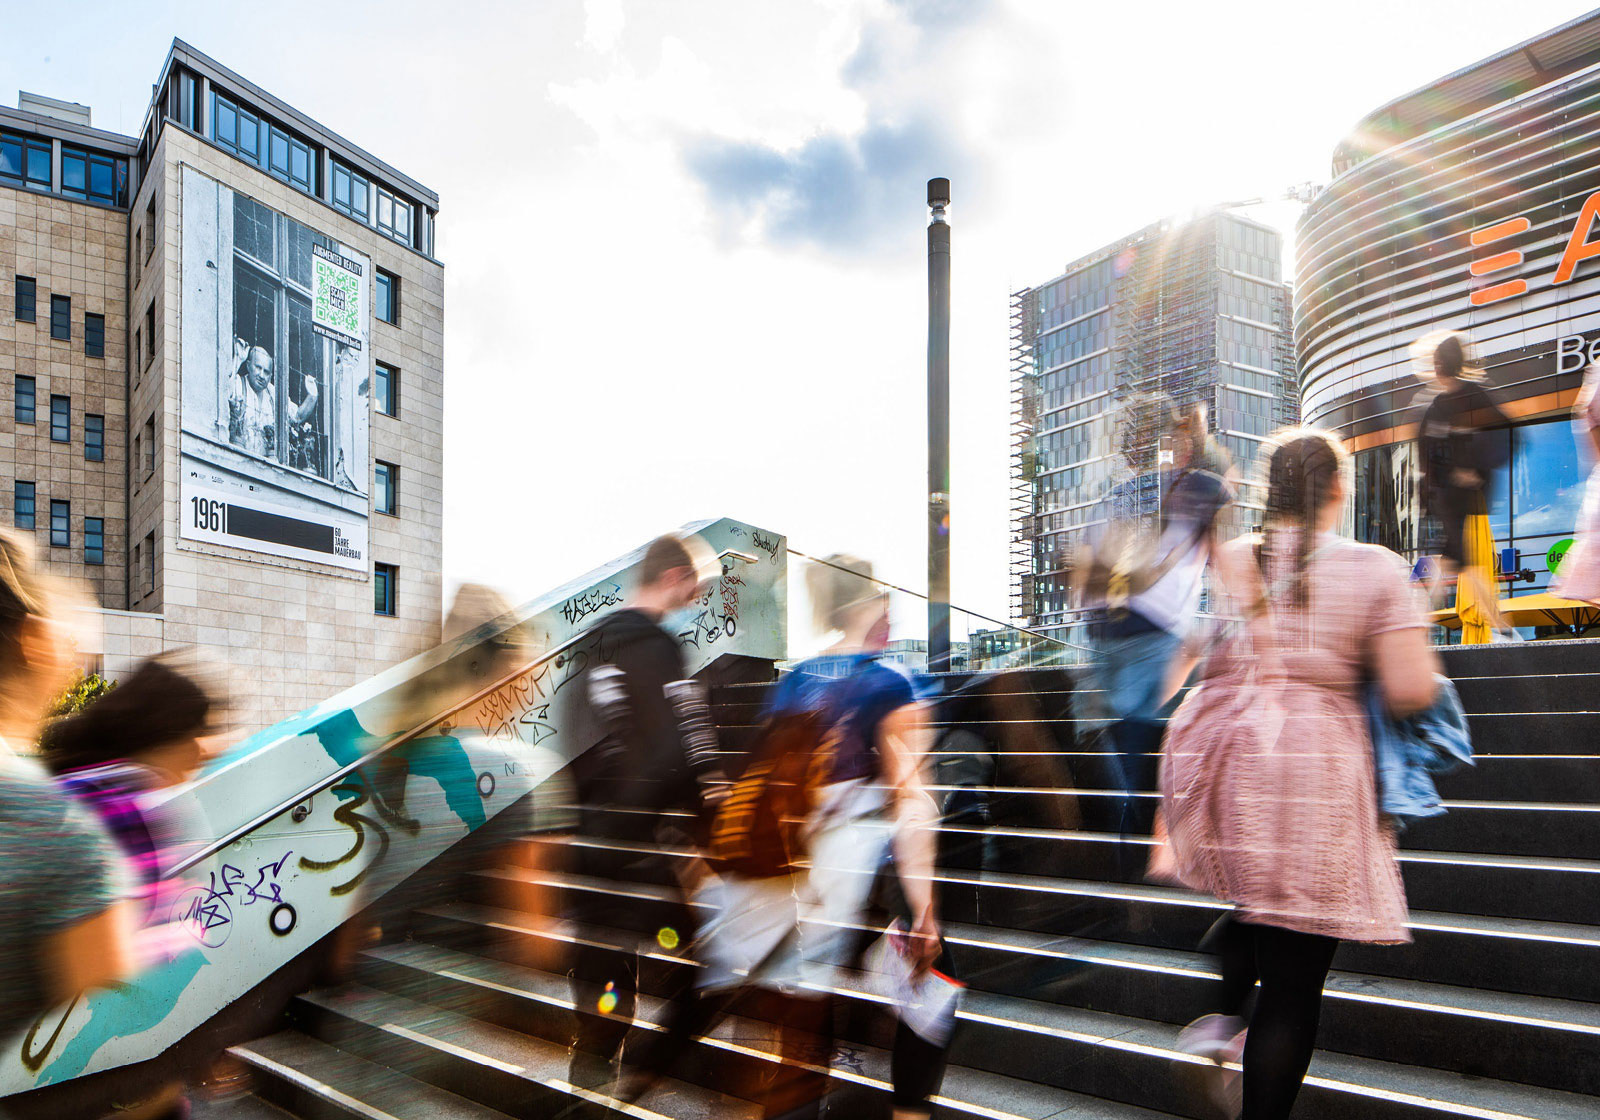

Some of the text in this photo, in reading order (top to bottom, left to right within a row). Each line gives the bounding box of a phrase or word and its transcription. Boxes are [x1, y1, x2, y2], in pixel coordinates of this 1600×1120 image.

[314, 244, 362, 275] AUGMENTED REALITY
[331, 287, 345, 300] SCAN
[331, 296, 345, 310] MICH
[191, 496, 226, 534] 1961
[335, 527, 341, 537] 60
[335, 537, 349, 548] JAHRE
[335, 547, 361, 560] MAUERBAU
